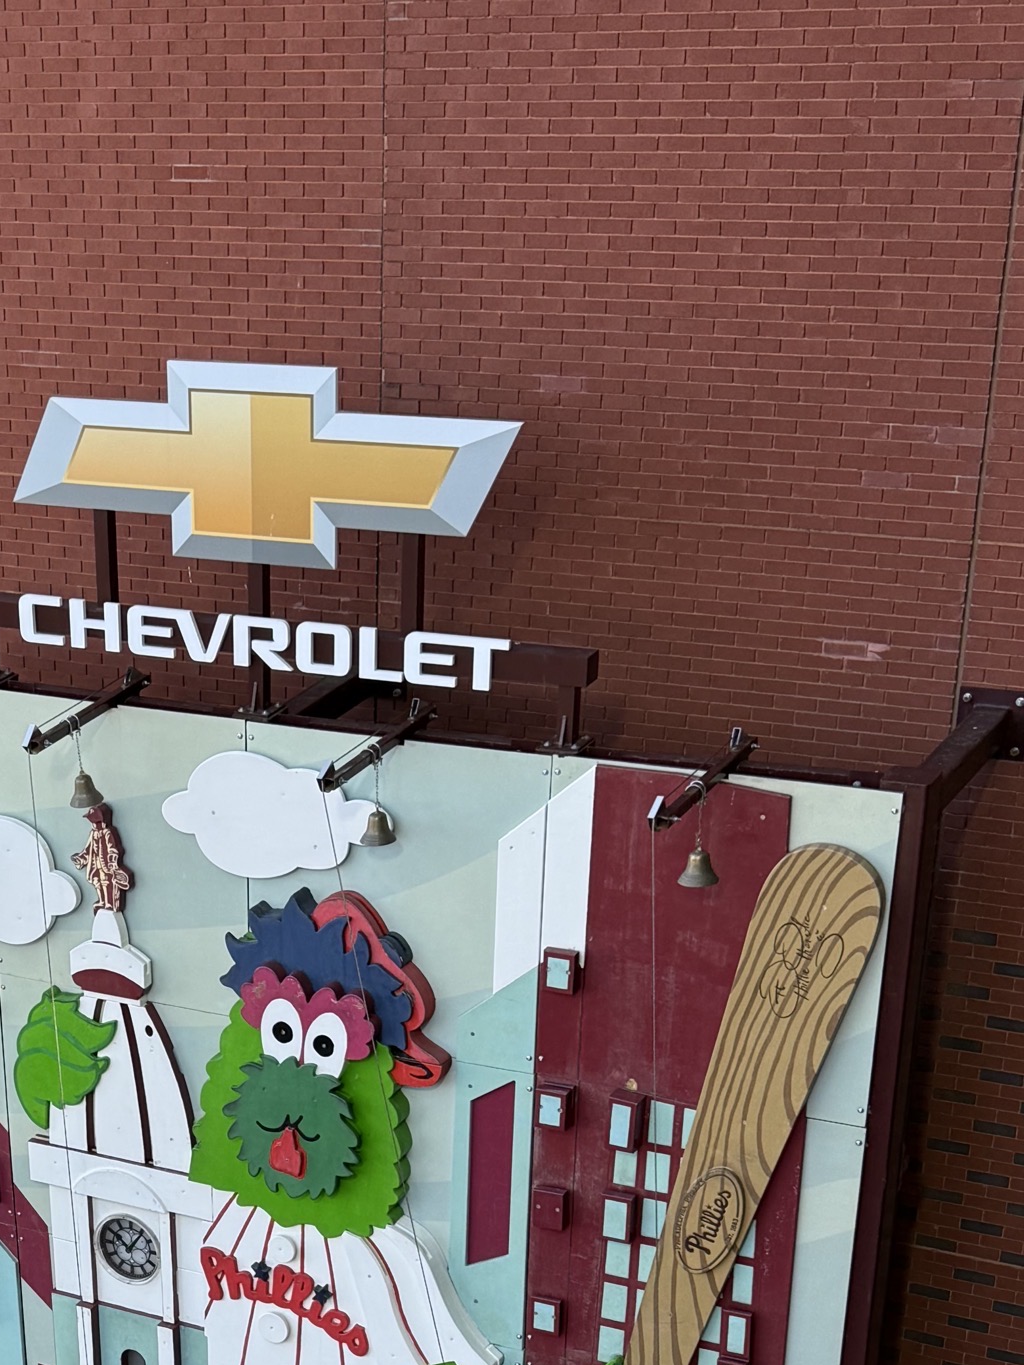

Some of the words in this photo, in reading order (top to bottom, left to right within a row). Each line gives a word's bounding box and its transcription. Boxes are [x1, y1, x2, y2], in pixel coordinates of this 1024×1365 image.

[18, 593, 511, 692] CHEVROLET
[684, 1190, 732, 1256] Phillies
[200, 1246, 370, 1357] Phillies
